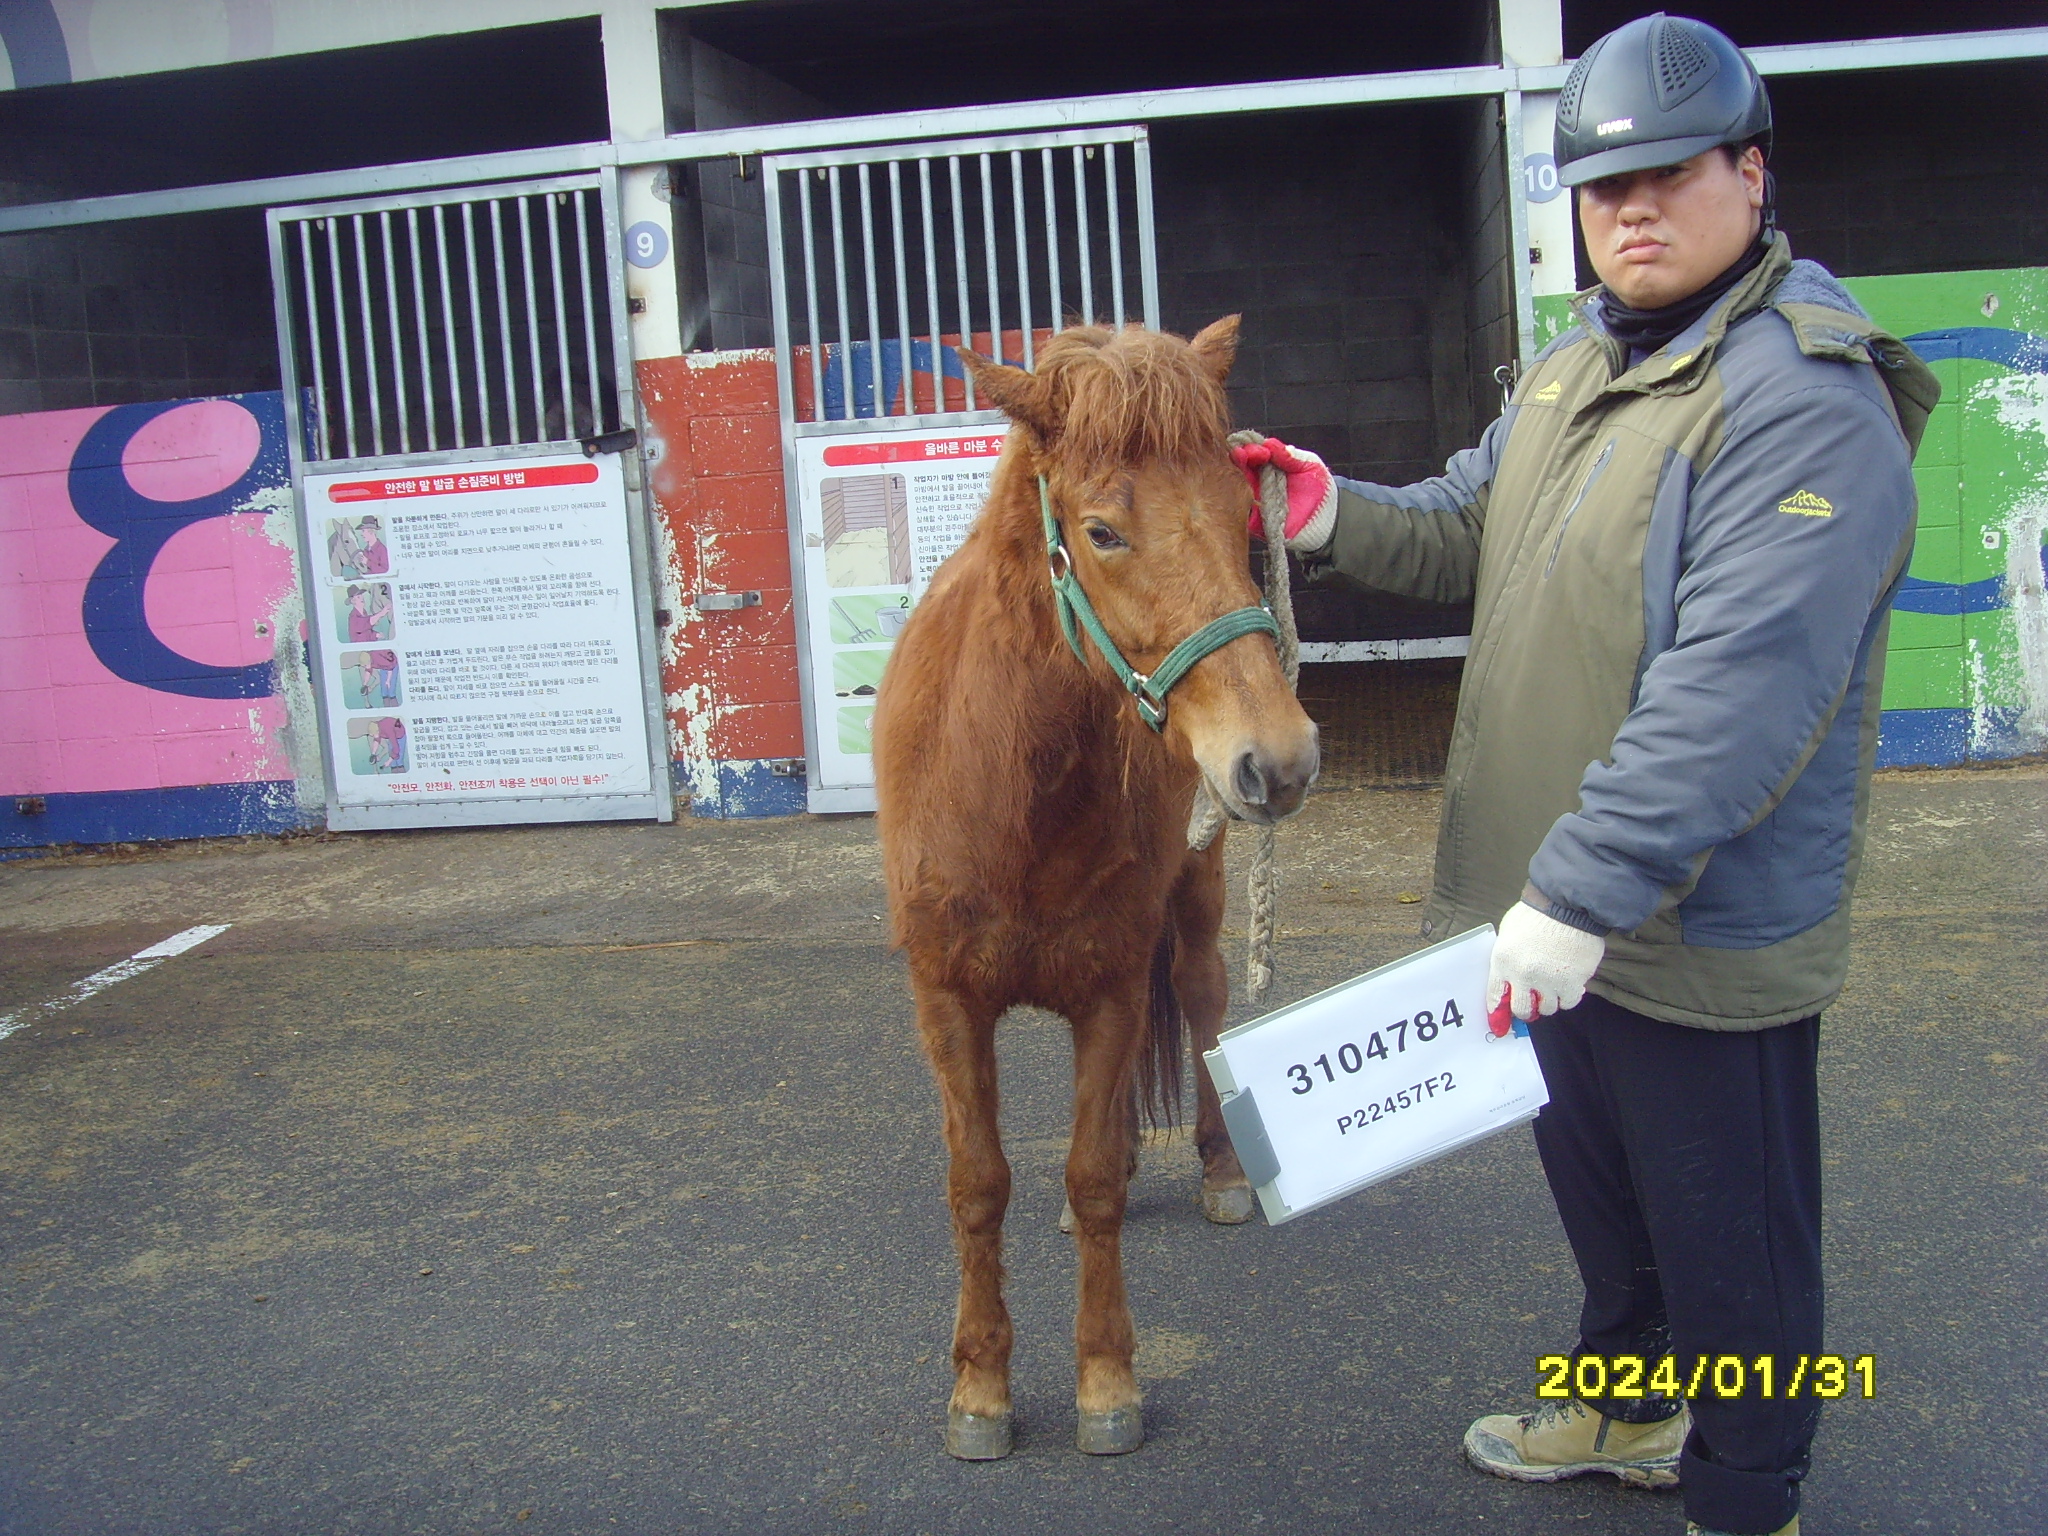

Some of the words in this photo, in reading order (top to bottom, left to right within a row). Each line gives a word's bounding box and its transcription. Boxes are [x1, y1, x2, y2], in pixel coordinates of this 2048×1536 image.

[1525, 164, 1557, 192] 10
[637, 232, 654, 258] 9
[924, 441, 960, 456] 올바른
[963, 440, 988, 453] 마분
[384, 480, 416, 494] 안전한
[419, 479, 430, 492] 말
[433, 477, 454, 490] 발굽
[457, 474, 499, 488] 손질준비
[503, 472, 524, 485] 방법
[892, 477, 898, 489] 1
[374, 517, 379, 528] 1
[380, 585, 388, 595] 2
[900, 596, 909, 608] 2
[387, 651, 394, 662] 3
[425, 781, 454, 792] 안전화,
[459, 779, 494, 790] 안전조끼
[498, 778, 526, 788] 착용은
[529, 776, 556, 787] 선택이
[561, 775, 579, 785] 아닌
[1287, 998, 1464, 1095] 3104784
[1336, 1071, 1457, 1135] P22457F2
